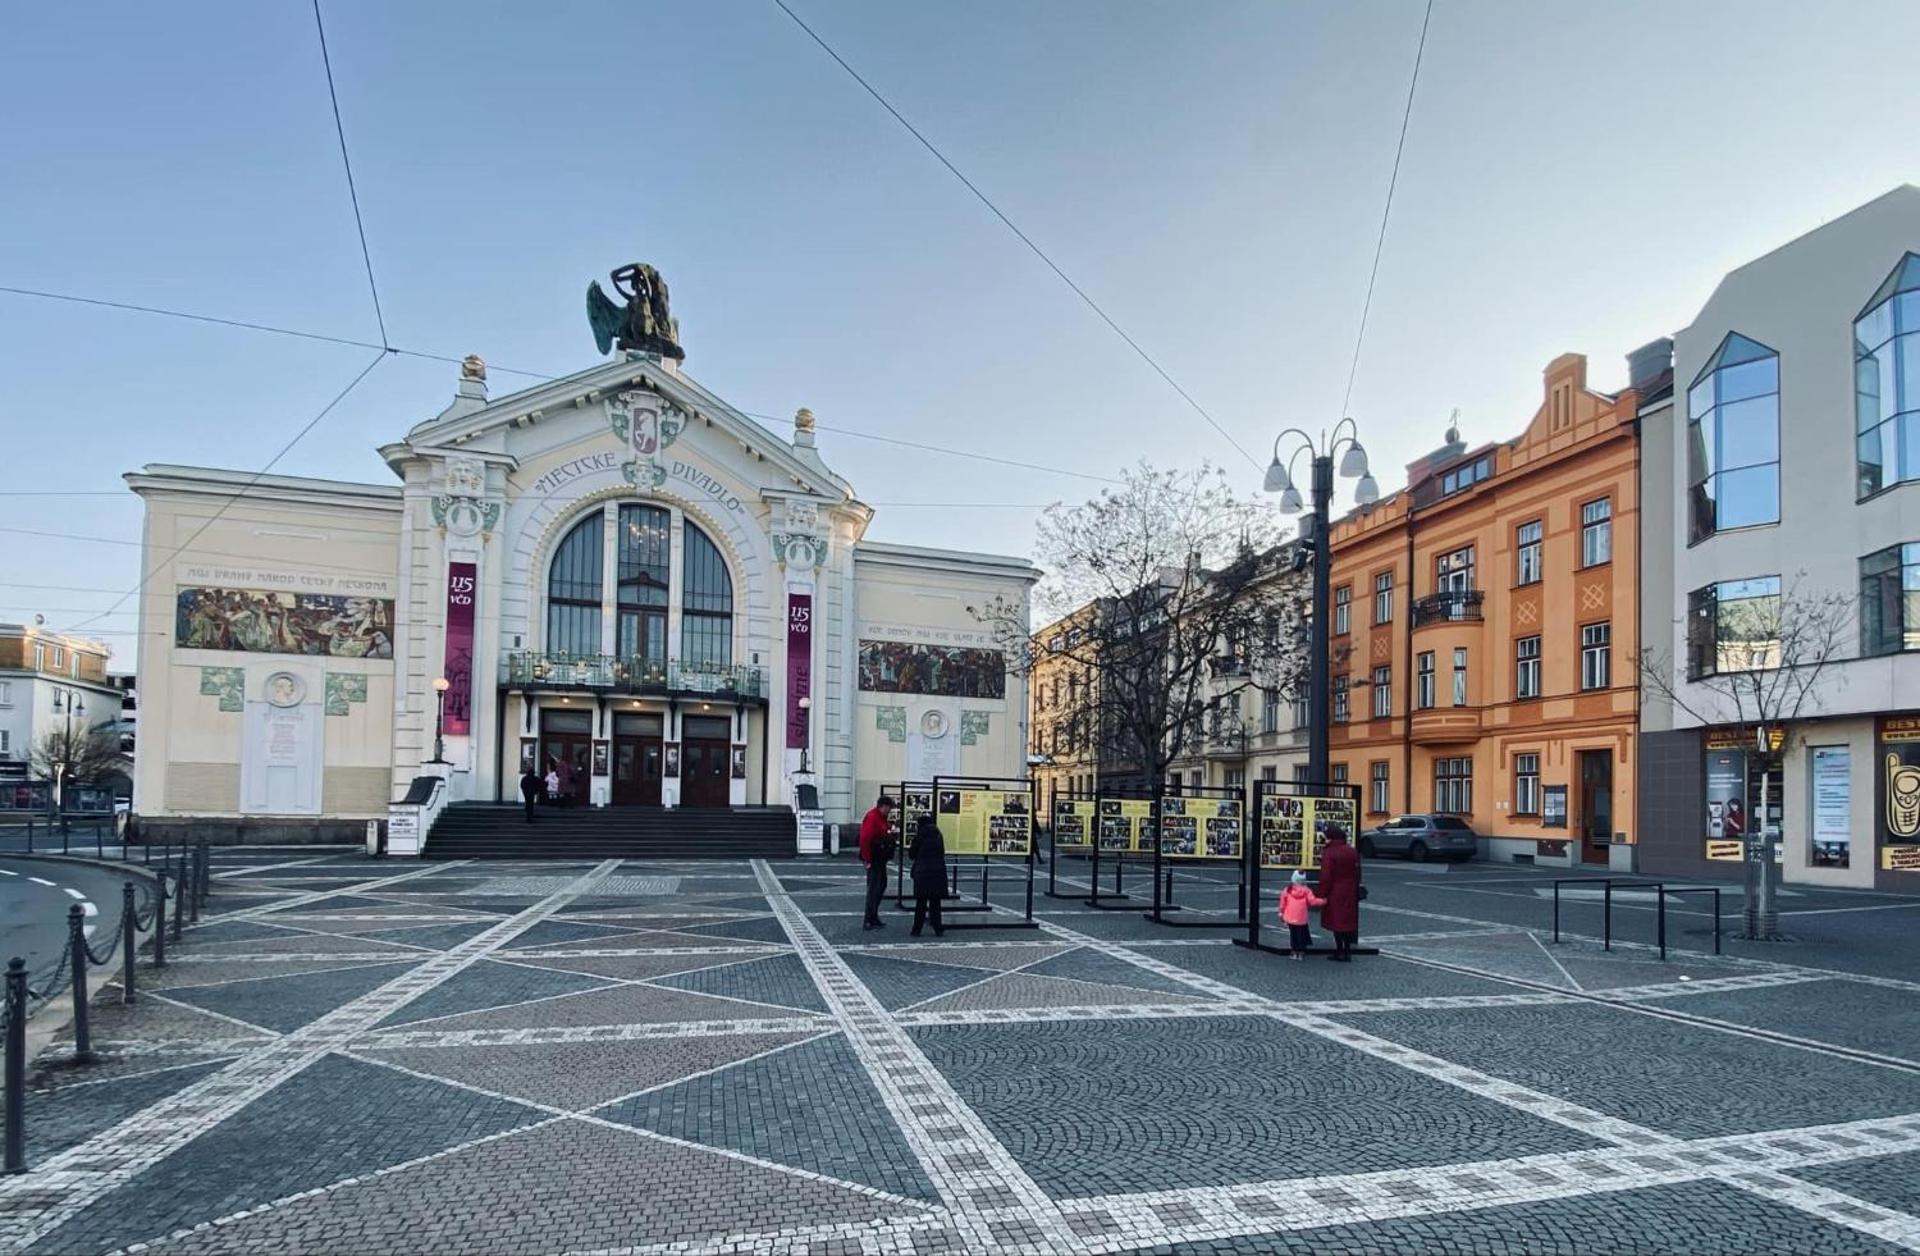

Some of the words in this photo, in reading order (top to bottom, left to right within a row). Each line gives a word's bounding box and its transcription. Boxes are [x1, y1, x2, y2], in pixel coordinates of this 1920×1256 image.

[672, 461, 740, 511] DIVADLO
[450, 576, 474, 592] 115
[450, 594, 472, 605] VČD
[790, 606, 810, 622] 115
[790, 622, 809, 634] VČD
